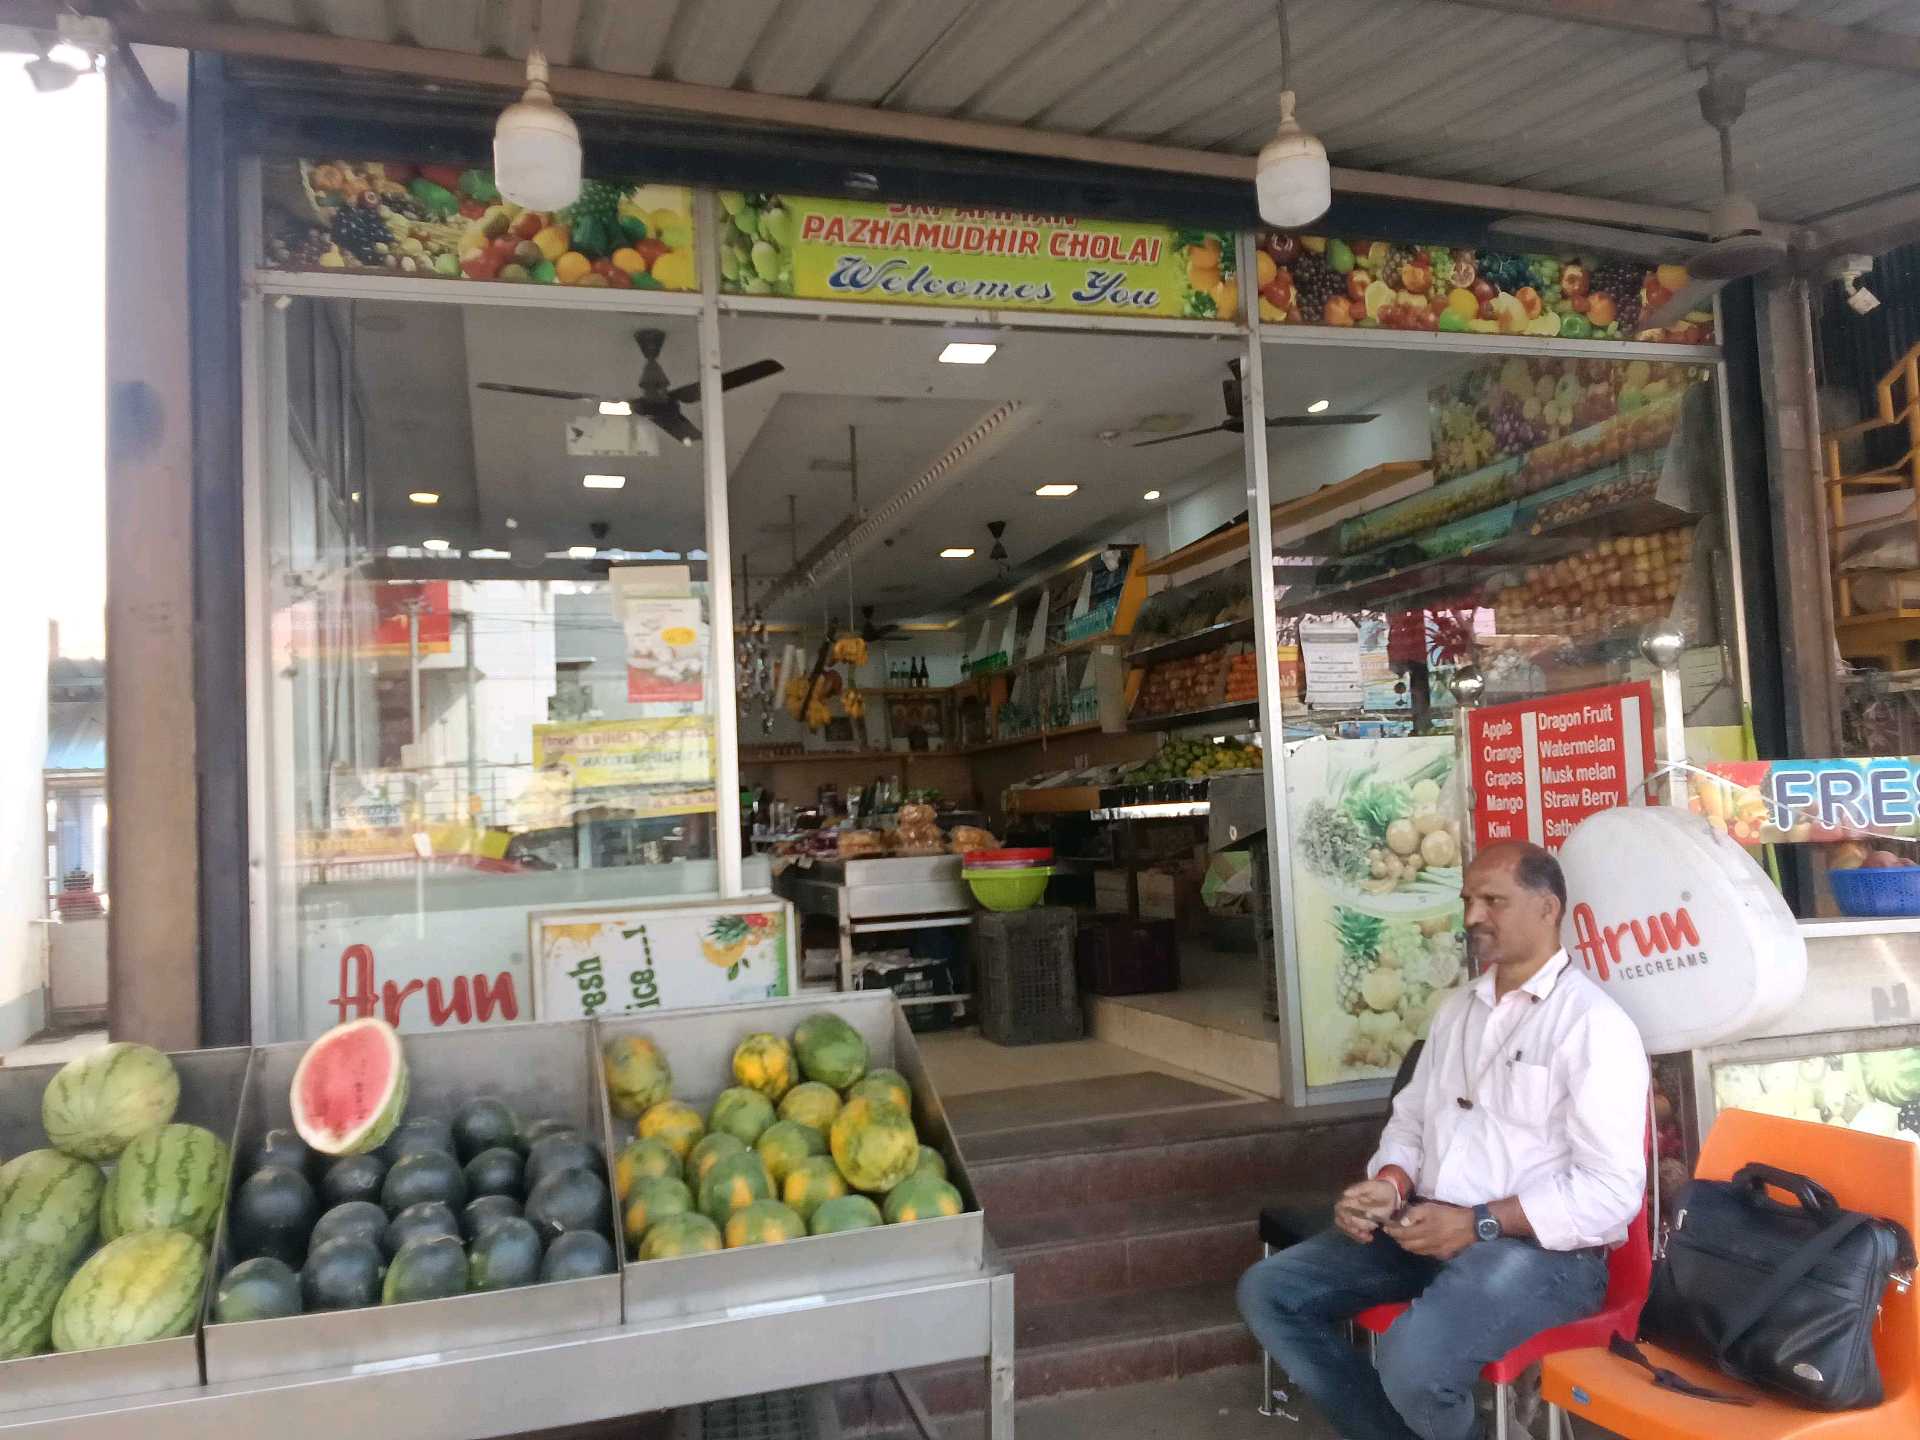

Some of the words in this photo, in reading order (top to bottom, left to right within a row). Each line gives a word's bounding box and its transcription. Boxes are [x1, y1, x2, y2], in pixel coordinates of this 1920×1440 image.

[801, 215, 1039, 256] PAZHAMUDHIR
[1048, 233, 1161, 264] CHOLAI
[828, 254, 1054, 302] Welcomes
[1070, 269, 1160, 307] You
[1482, 719, 1513, 741] Apple
[1538, 712, 1582, 732] Dragon
[1583, 703, 1614, 725] Fruit
[1483, 744, 1523, 764] Orange
[1485, 770, 1524, 790] Grapes
[1541, 764, 1575, 785] Musk
[1486, 794, 1524, 815] Mango
[1543, 789, 1581, 809] Straw
[1581, 788, 1619, 808] Berry
[1772, 767, 1920, 833] FRE
[1487, 820, 1512, 839] Kiwi
[1573, 902, 1700, 981] Arun
[1619, 951, 1709, 981] ICECREAMS
[328, 943, 520, 1029] Arun
